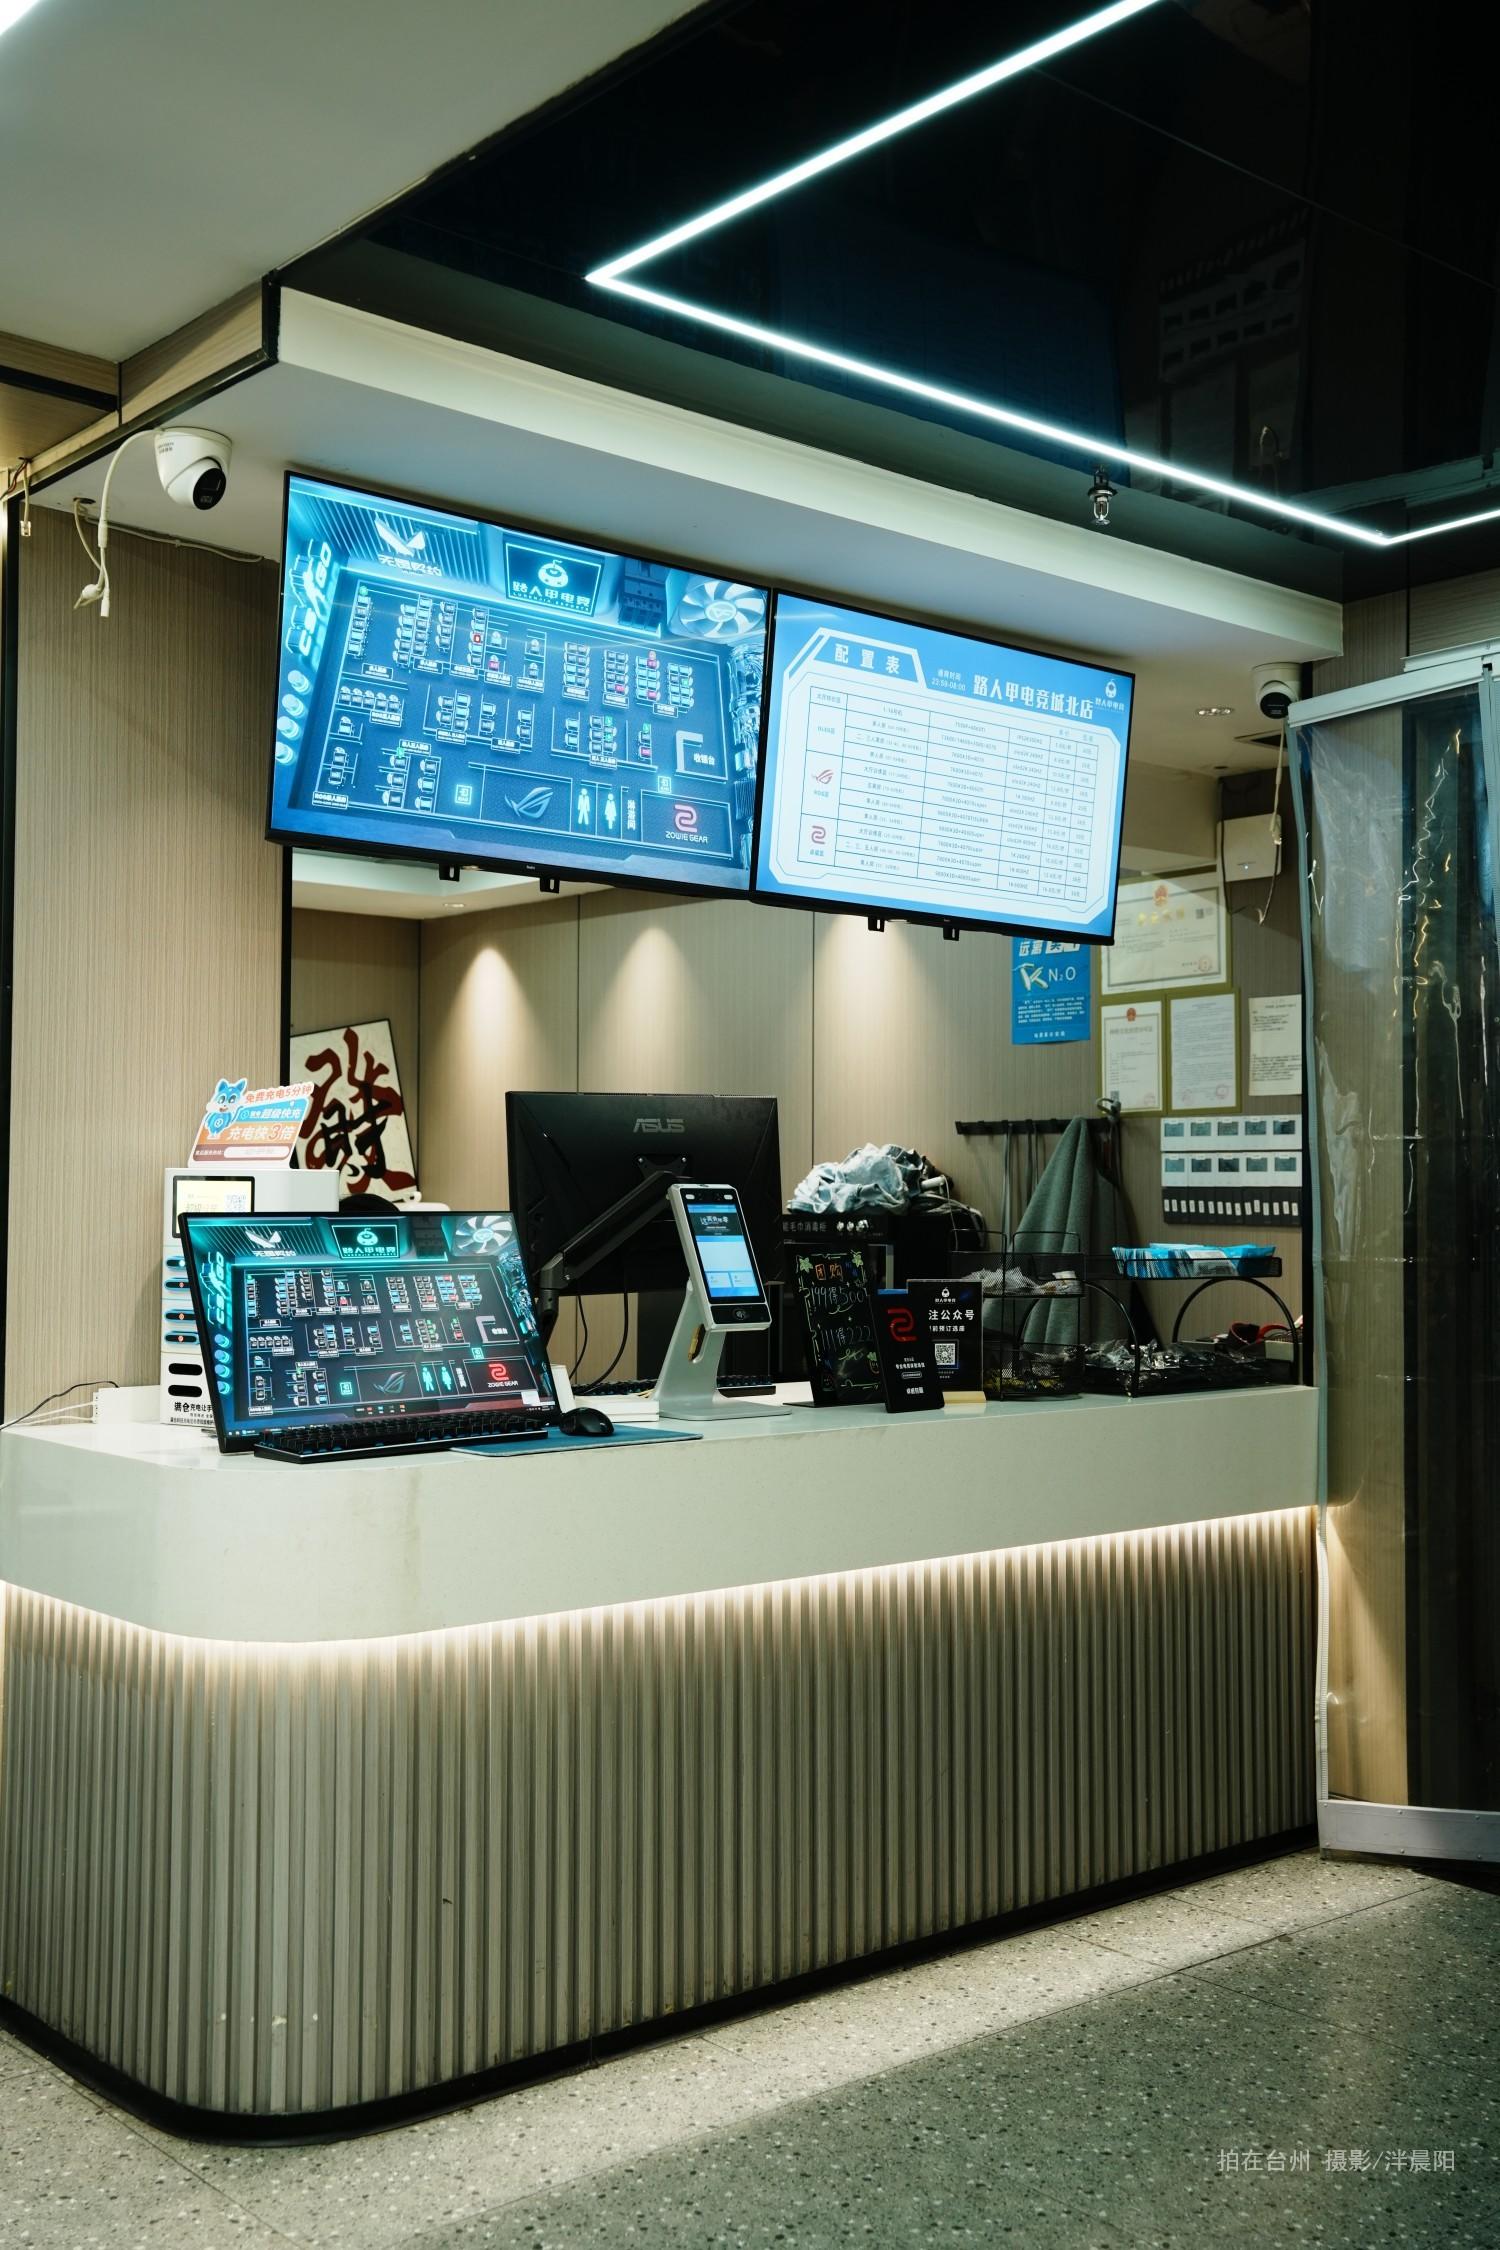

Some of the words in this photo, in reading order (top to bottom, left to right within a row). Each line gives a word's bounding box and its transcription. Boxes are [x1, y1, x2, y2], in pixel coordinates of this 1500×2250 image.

[512, 581, 591, 606] 路人甲电竞
[833, 643, 900, 675] 配置表
[973, 674, 1094, 720] 路人甲电竞城北店
[665, 831, 688, 841] ZOWIE
[689, 833, 708, 844] GEAR
[245, 1084, 312, 1104] 免费充电5分钟
[226, 1123, 297, 1141] 充电快3倍
[633, 1118, 686, 1133] ASUS
[928, 1309, 975, 1321] 注公众号
